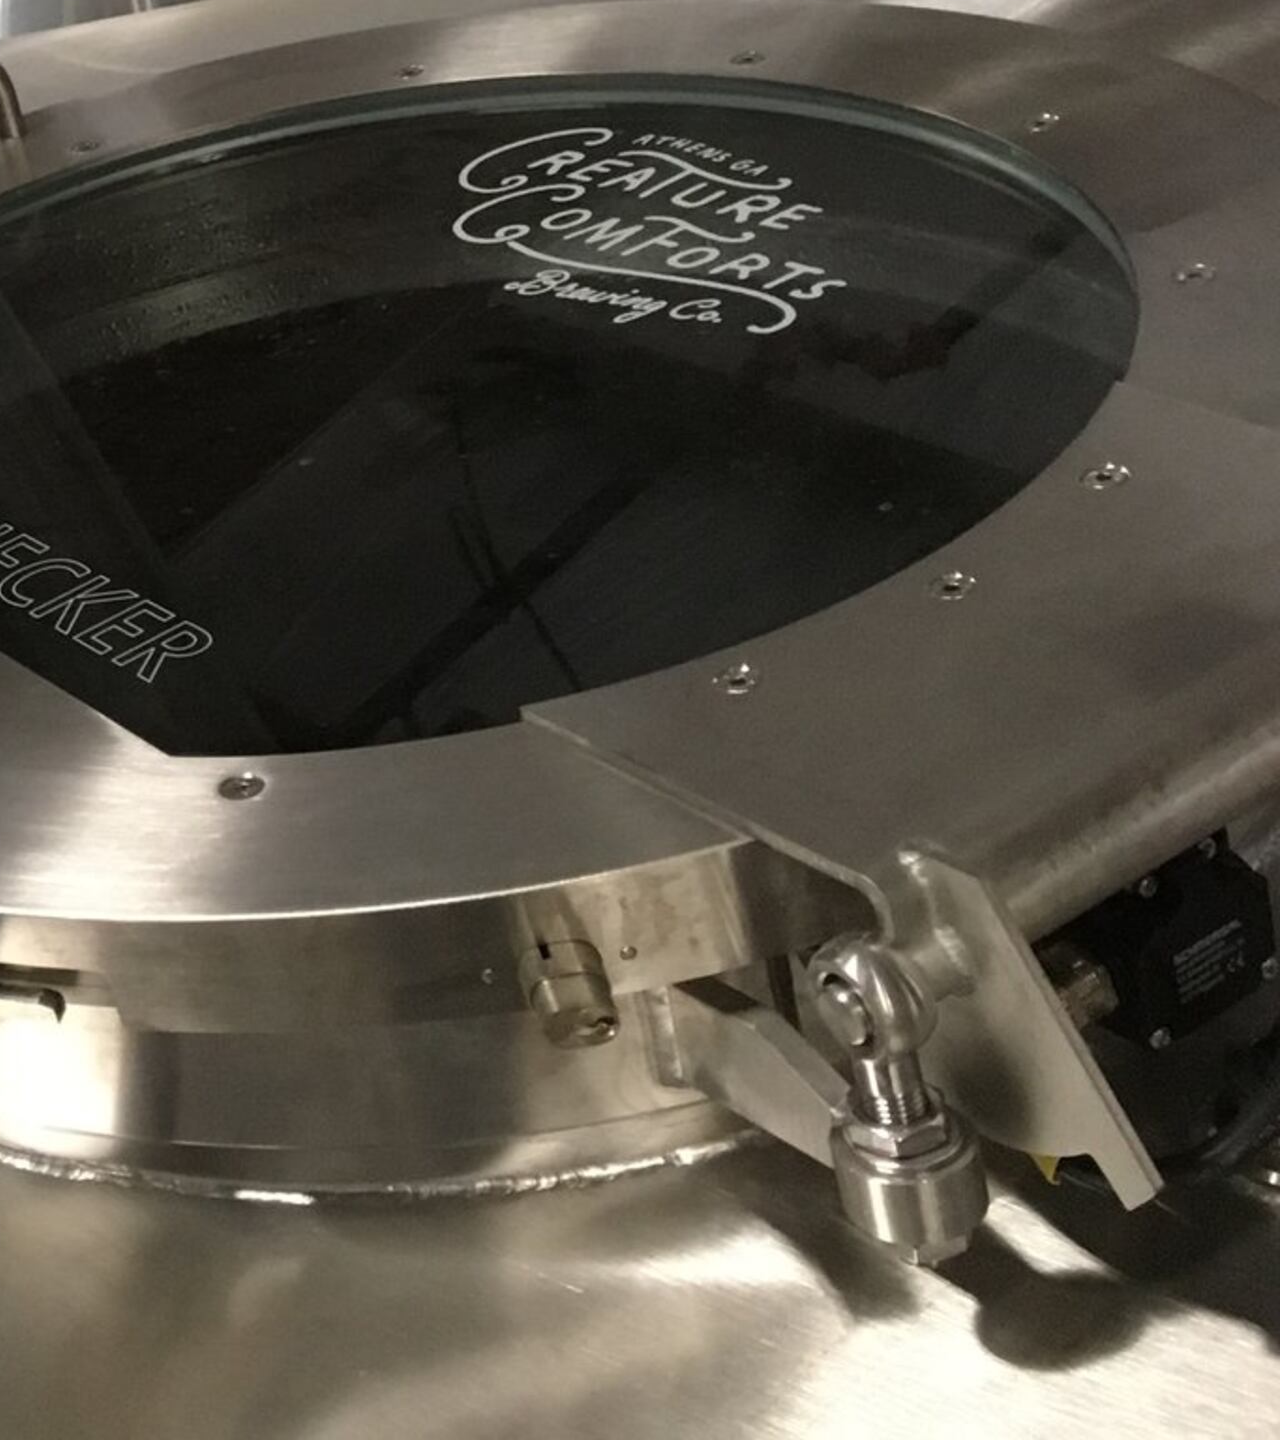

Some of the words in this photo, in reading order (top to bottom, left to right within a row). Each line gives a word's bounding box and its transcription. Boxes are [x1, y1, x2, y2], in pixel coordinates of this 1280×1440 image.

[458, 127, 824, 230] CREATURE
[632, 133, 726, 163] ATHENS
[730, 159, 770, 177] GA
[452, 183, 847, 302] COMFORTS
[503, 269, 668, 324] Brewing
[669, 298, 722, 324] Co.
